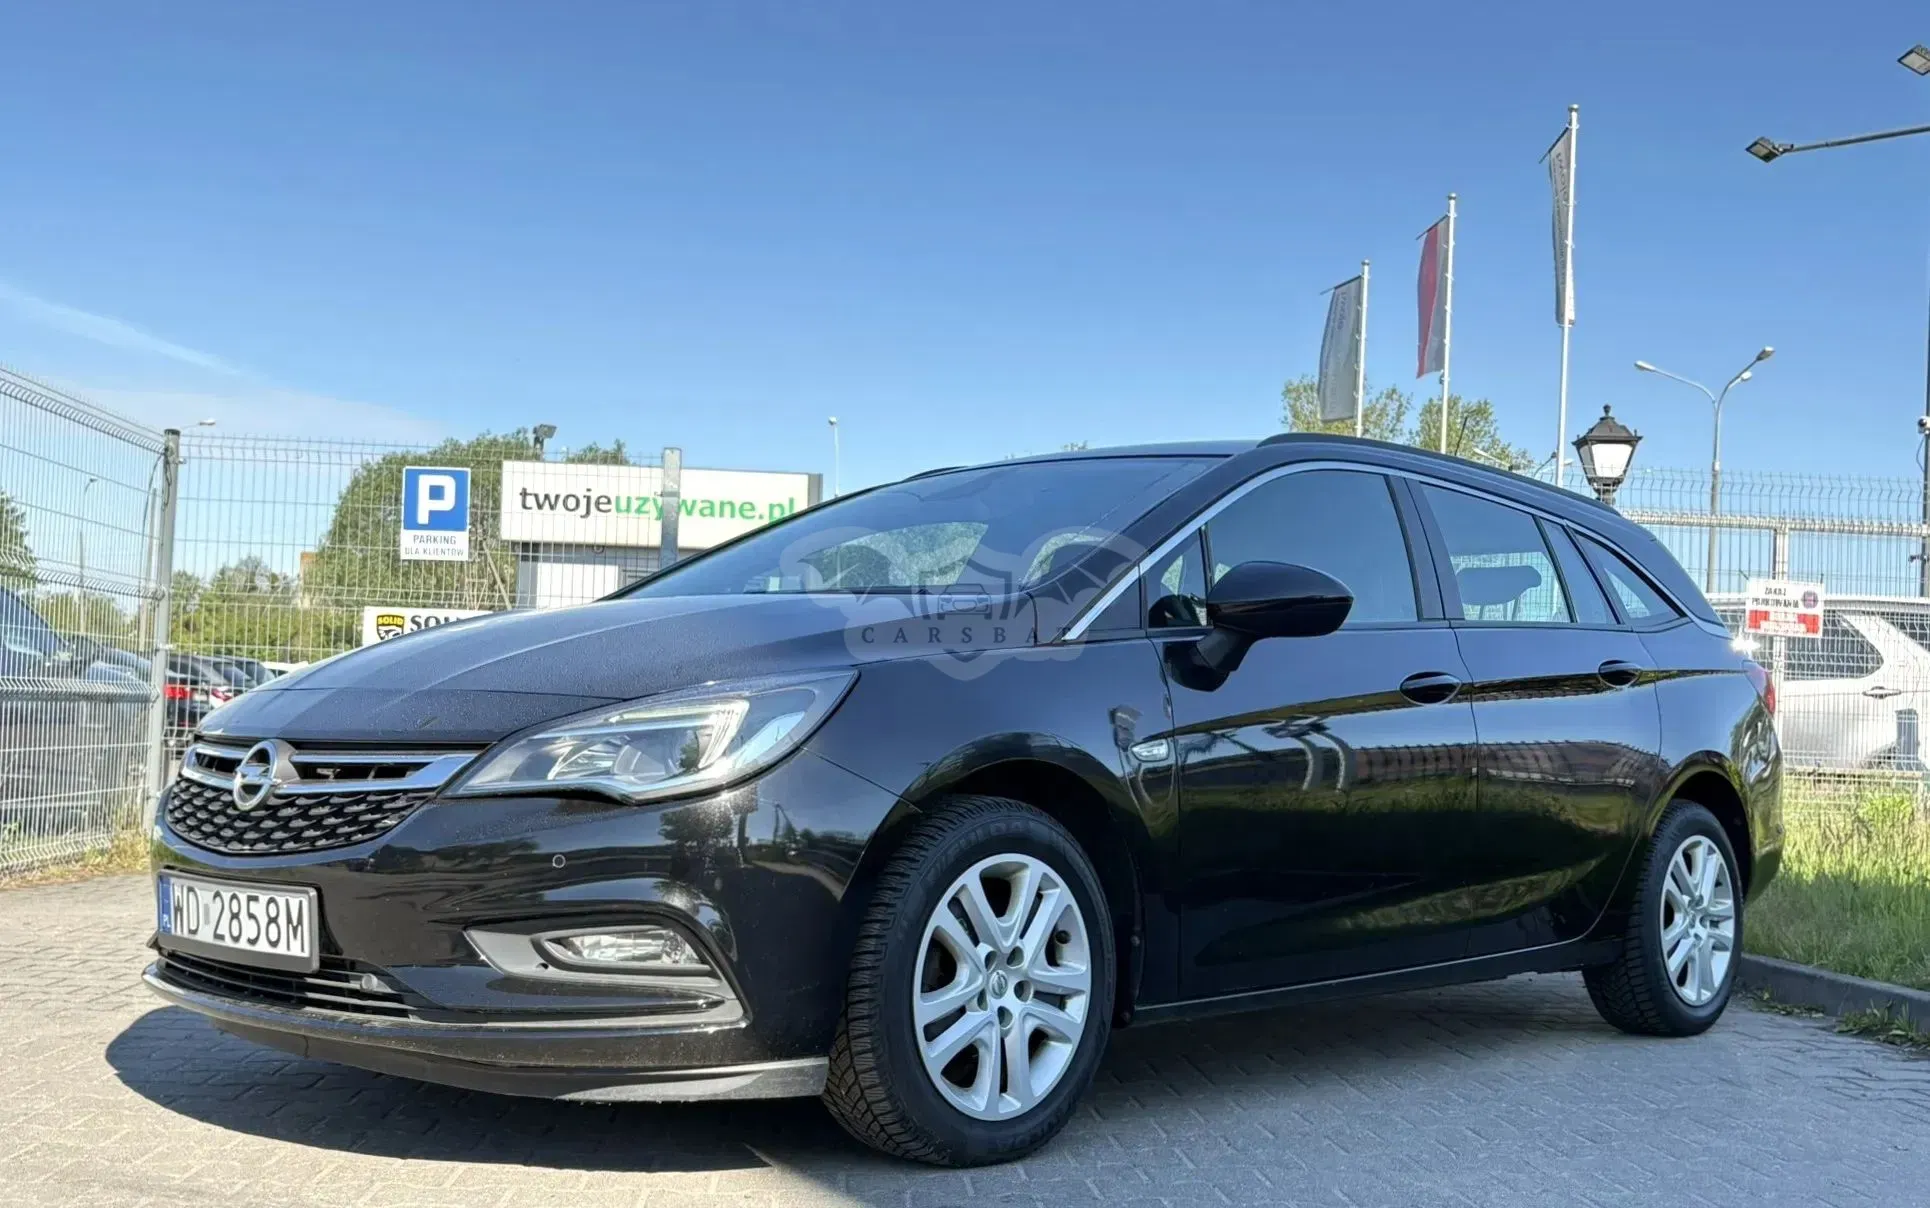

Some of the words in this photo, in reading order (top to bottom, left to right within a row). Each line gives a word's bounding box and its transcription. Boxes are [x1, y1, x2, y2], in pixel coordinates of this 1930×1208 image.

[417, 474, 456, 525] P
[413, 534, 457, 545] PARKING
[377, 616, 404, 626] SOLID
[410, 615, 464, 632] SO
[172, 882, 201, 936] WD
[212, 889, 306, 954] 2858M
